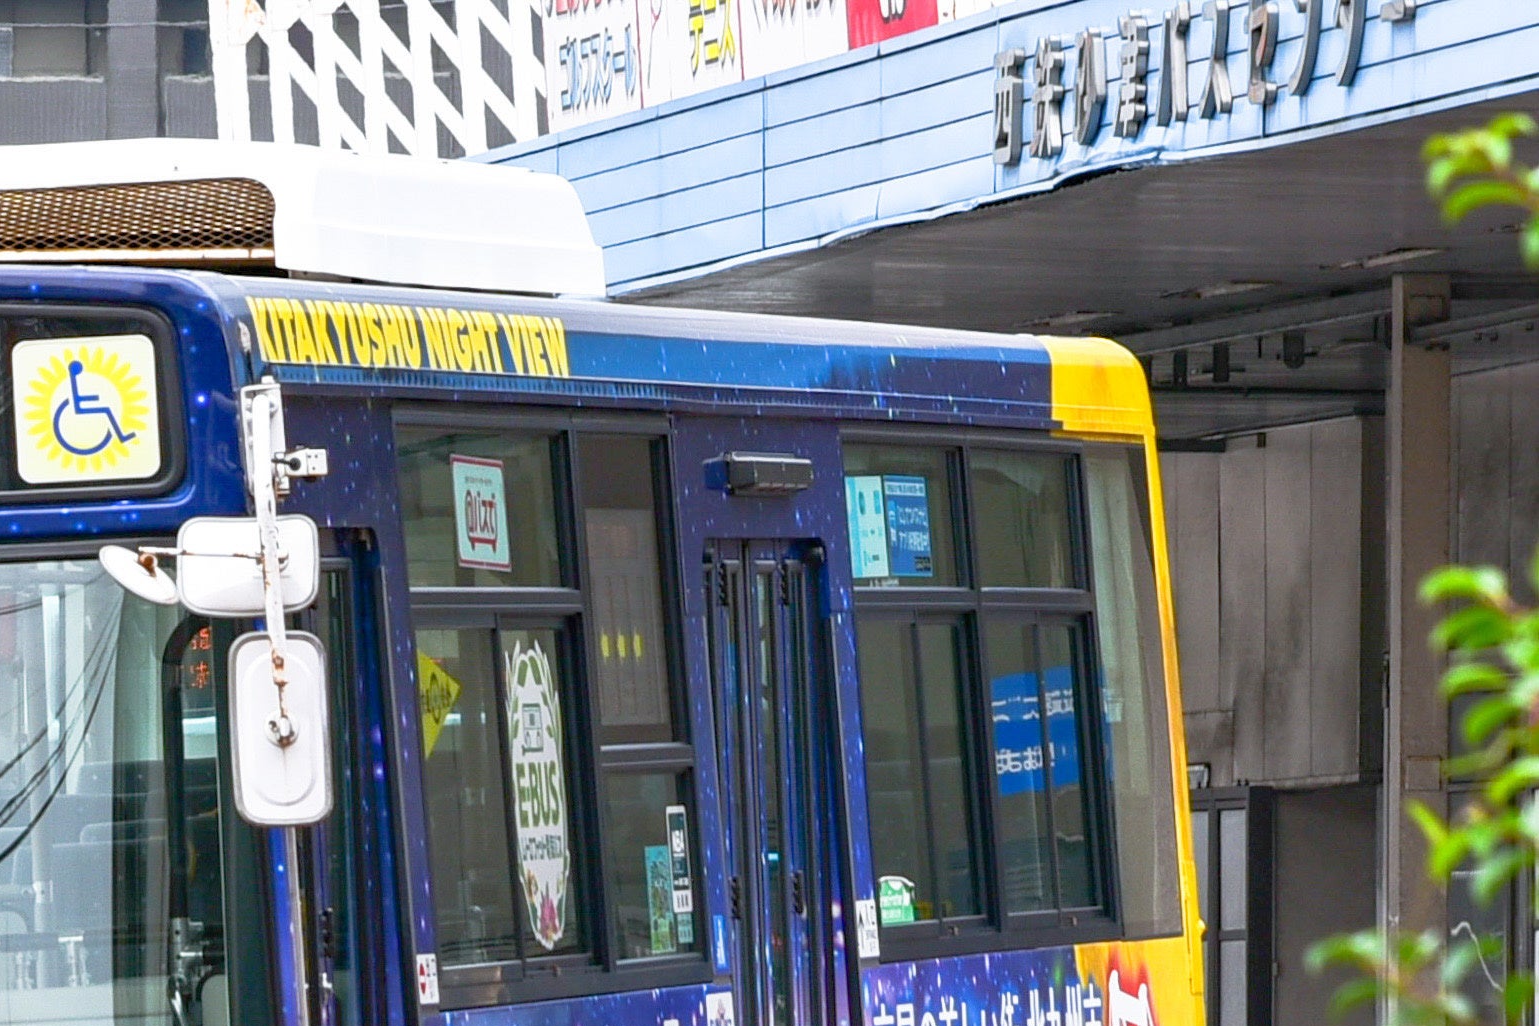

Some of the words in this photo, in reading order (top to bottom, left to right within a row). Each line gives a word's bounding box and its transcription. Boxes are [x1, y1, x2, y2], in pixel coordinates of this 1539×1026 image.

[245, 296, 422, 370] KITAKYUSHU
[415, 306, 504, 373] NIGHT
[496, 312, 569, 378] VIEW
[515, 760, 560, 829] E-BUS
